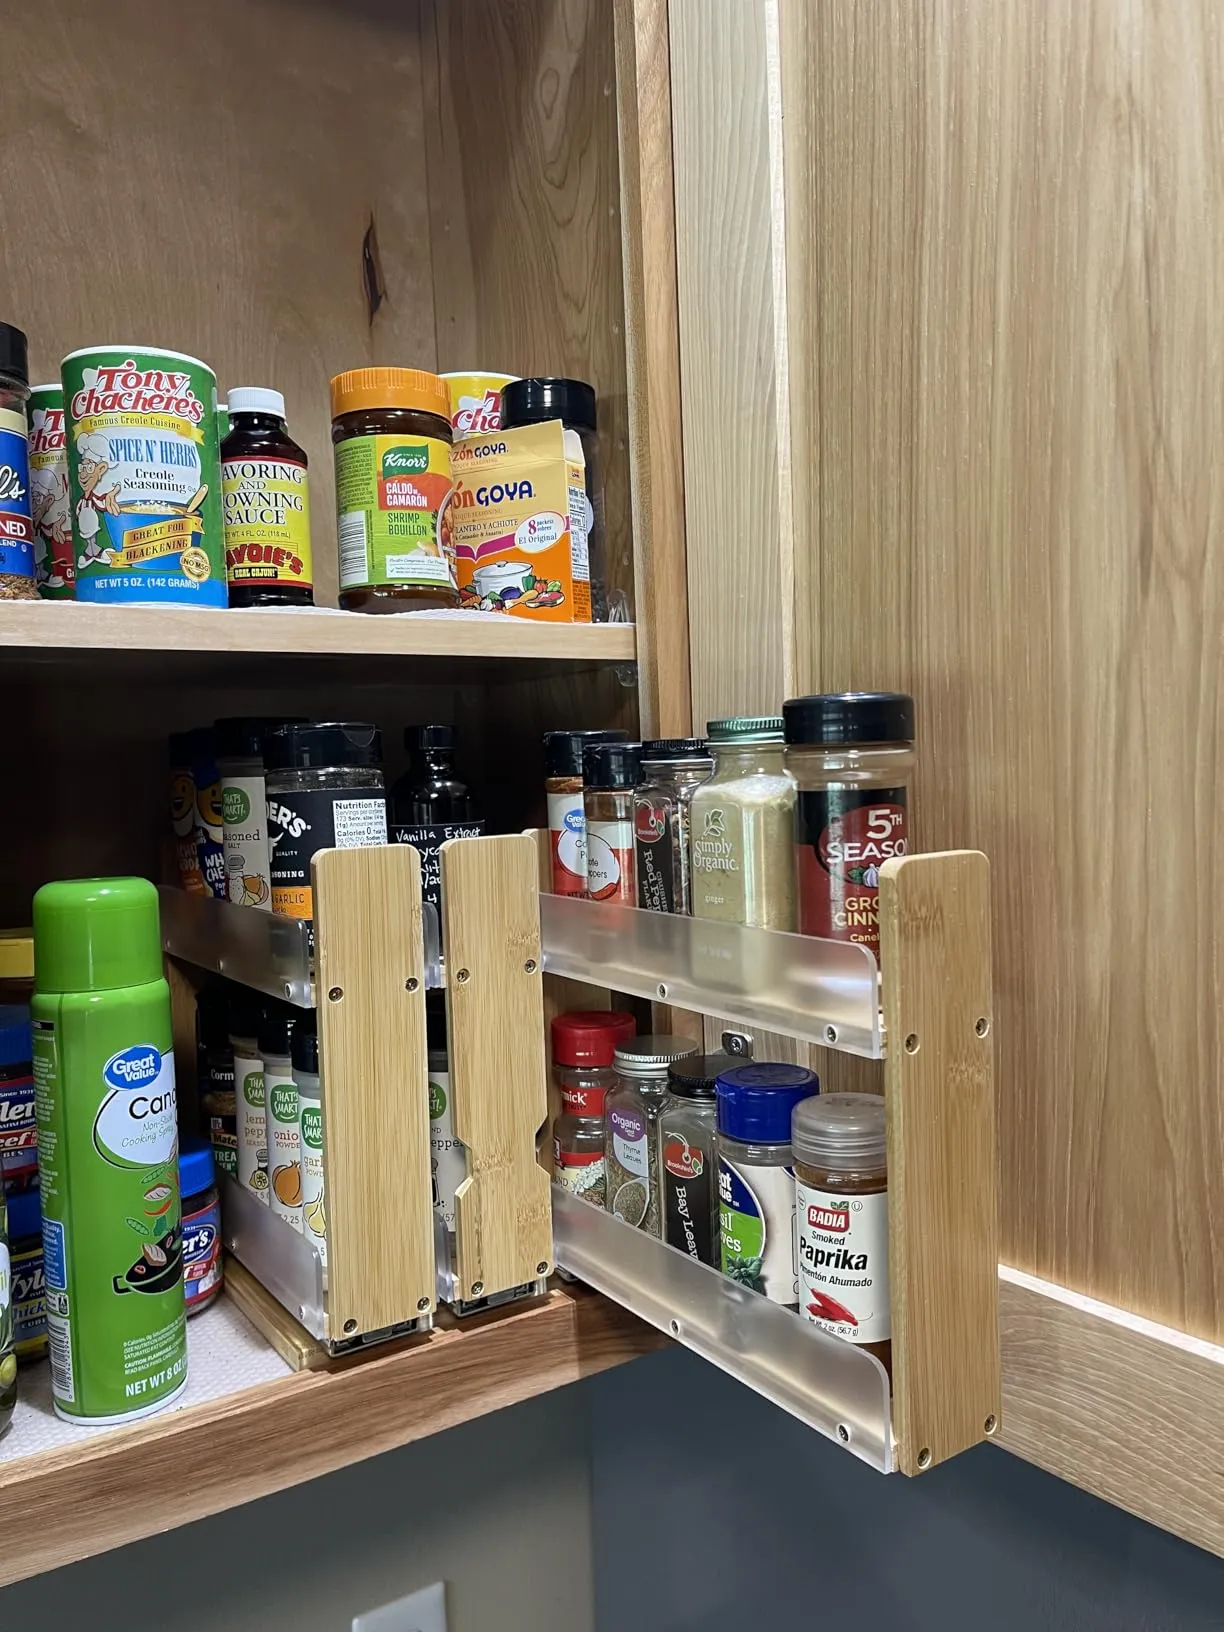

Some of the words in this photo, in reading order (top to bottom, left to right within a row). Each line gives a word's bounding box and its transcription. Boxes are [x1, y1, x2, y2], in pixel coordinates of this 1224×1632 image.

[97, 360, 191, 396] Tony
[71, 387, 204, 423] Chachere's
[89, 416, 119, 427] Famous
[120, 415, 148, 425] Creole
[150, 416, 181, 430] Cuisine
[108, 438, 144, 462] SPICE
[160, 440, 197, 468] HERBS
[384, 453, 427, 468] Knorr
[135, 468, 175, 481] Creole
[123, 478, 187, 494] Seasoning
[239, 481, 266, 490] AND
[223, 492, 303, 511] OWNING
[387, 494, 427, 507] CAMARÓN
[226, 509, 285, 525] SAUCE
[388, 512, 420, 524] SHRIMP
[489, 519, 518, 528] ACHIOTE
[133, 526, 164, 541] GREAT
[167, 522, 185, 533] FOR
[388, 524, 427, 536] BOUILLON
[528, 519, 537, 535] 8
[518, 536, 526, 544] El
[528, 532, 557, 543] Original
[126, 538, 188, 561] BLACKENING
[184, 558, 194, 566] NO
[196, 562, 209, 572] MSG
[235, 568, 251, 577] REAL
[95, 579, 108, 589] NET
[109, 579, 121, 587] WT
[123, 578, 129, 587] 5
[131, 578, 145, 587] OZ.
[147, 578, 167, 588] (142
[168, 578, 200, 590] GRAMS)
[335, 801, 372, 809] Nutrition
[337, 829, 365, 837] Calories
[366, 826, 372, 835] 0
[396, 829, 436, 842] Vanilla
[443, 826, 481, 839] Extract
[695, 837, 732, 857] Simply
[826, 838, 907, 864] SEASO
[112, 1054, 154, 1075] Great
[124, 1067, 155, 1082] Value
[612, 1112, 641, 1131] Organic
[122, 1131, 157, 1147] Cooking
[623, 1143, 641, 1155] Thyme
[675, 1185, 690, 1219] Bay
[810, 1208, 846, 1228] BADIA
[811, 1230, 846, 1246] Smoked
[800, 1236, 868, 1270] Paprika
[829, 1276, 873, 1287] Ahumado
[125, 1379, 148, 1397] NET
[149, 1370, 166, 1389] WT
[166, 1367, 172, 1380] 8
